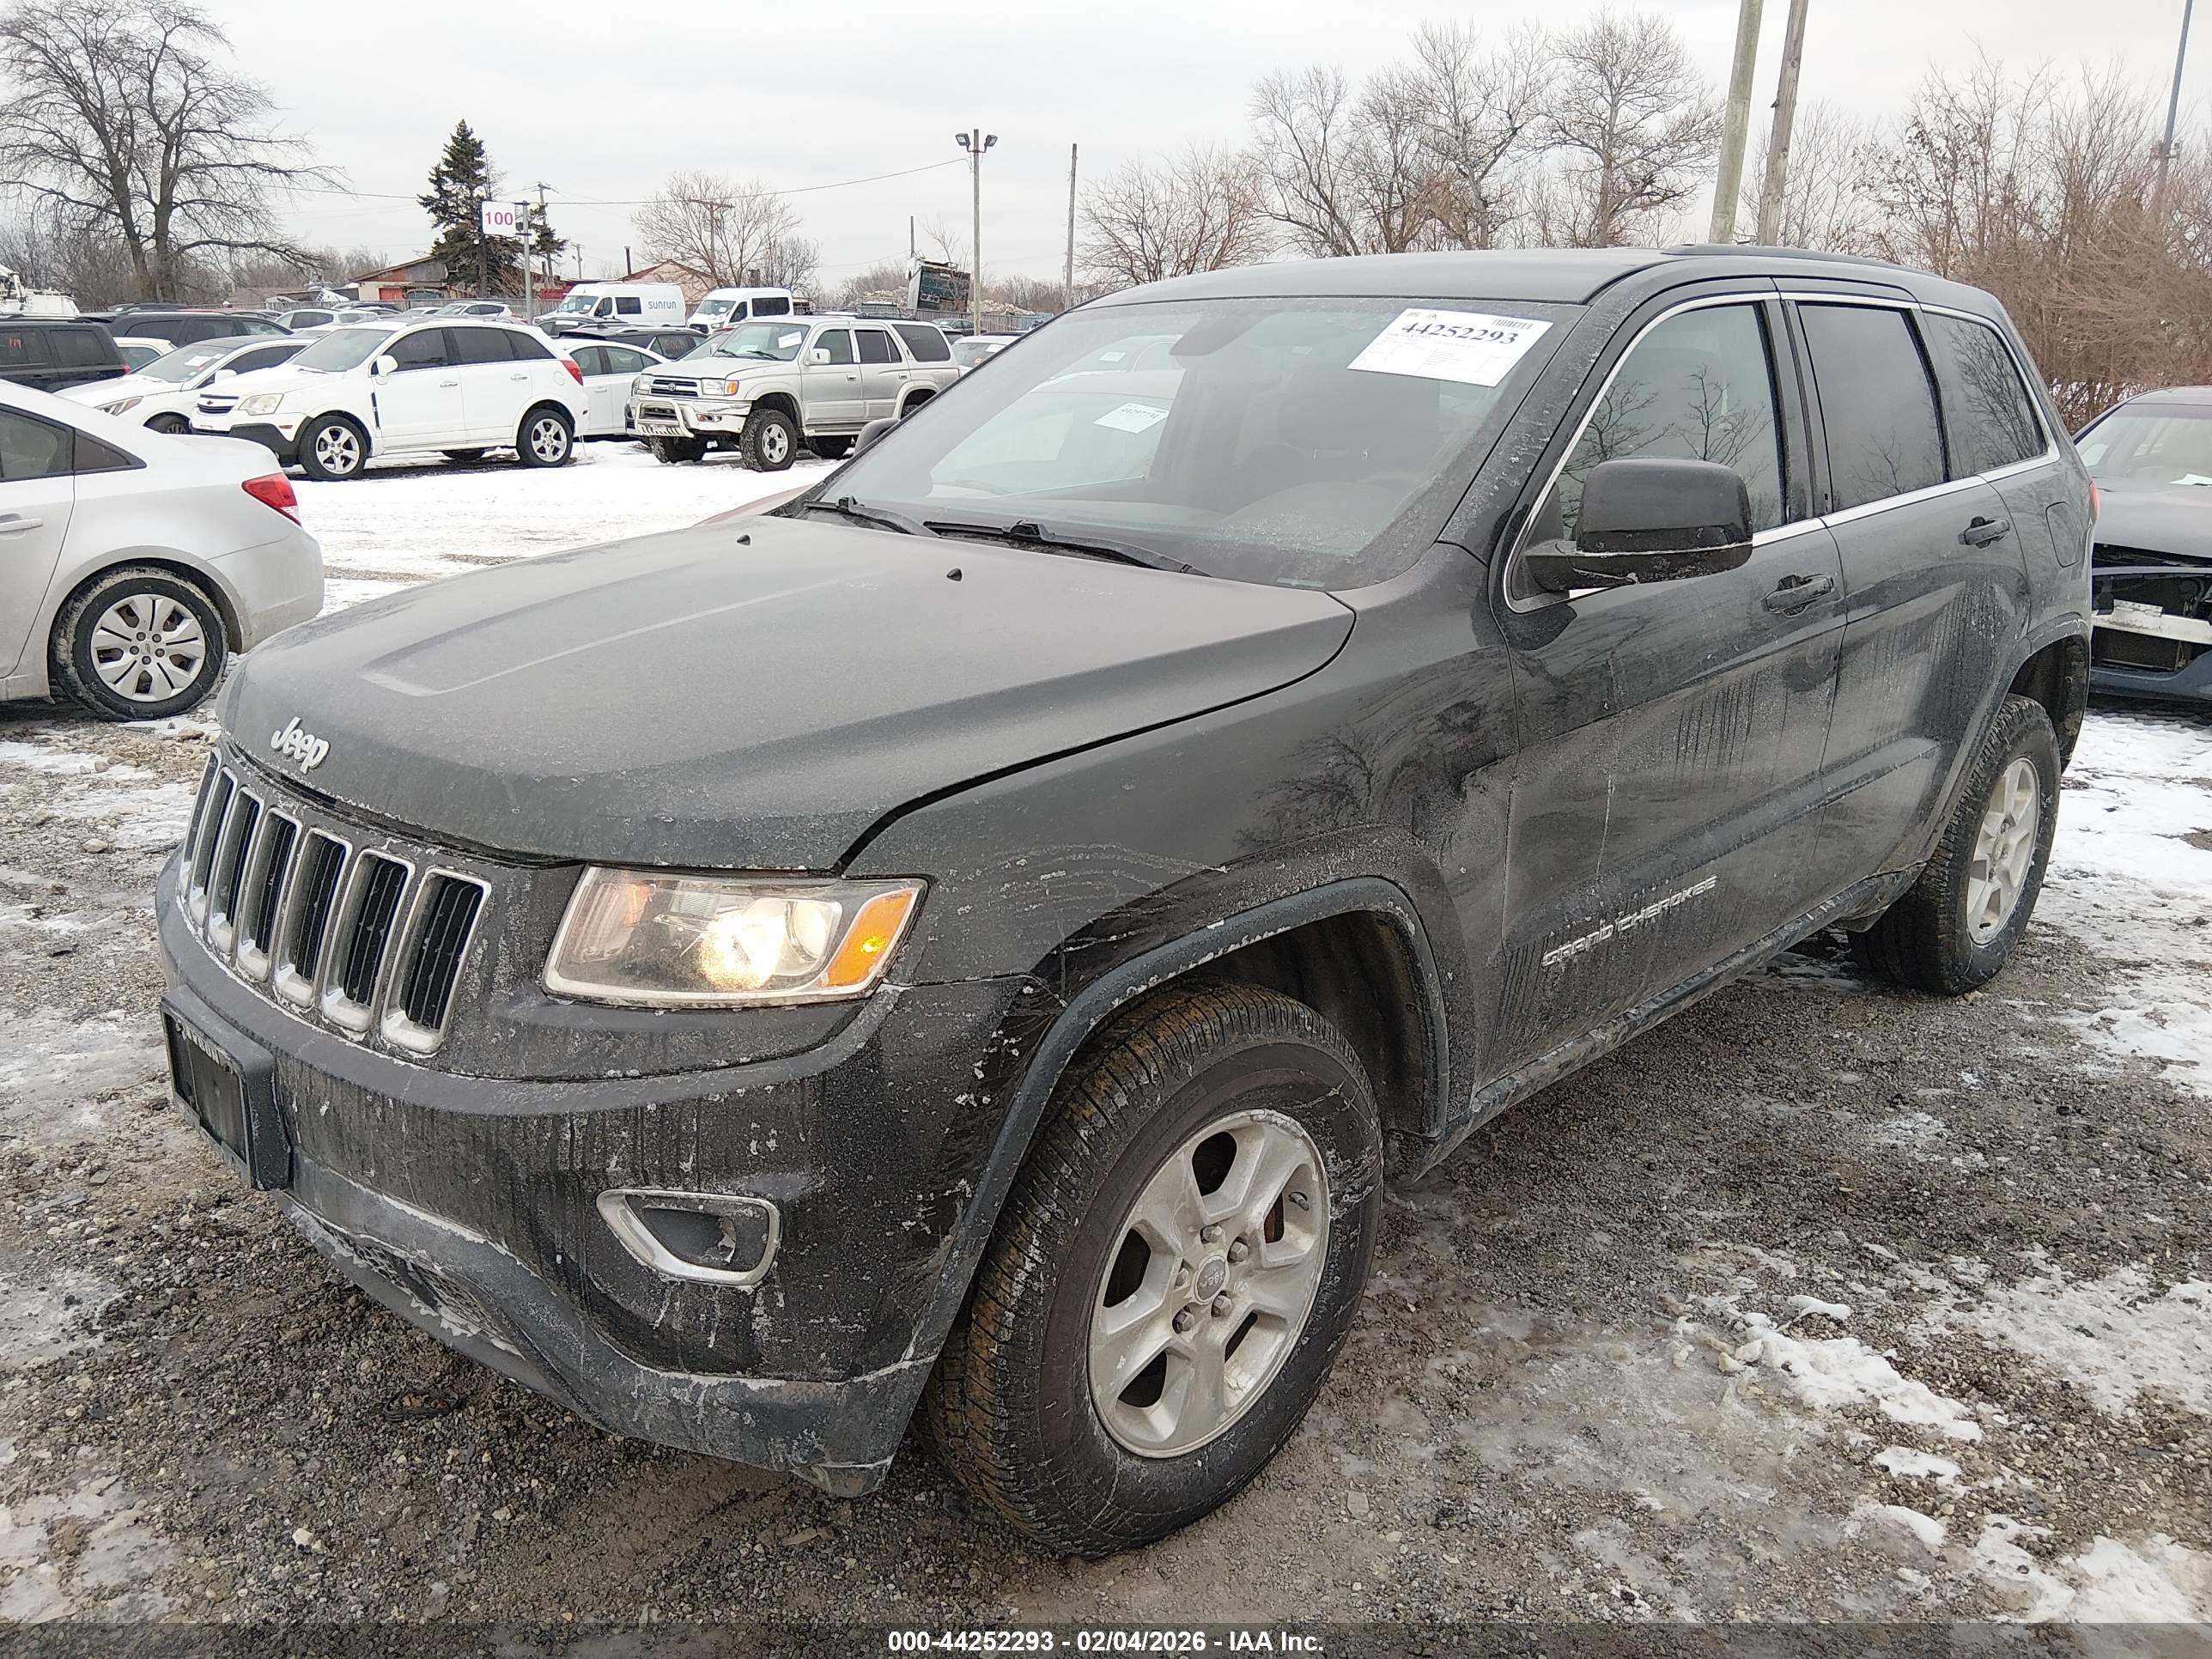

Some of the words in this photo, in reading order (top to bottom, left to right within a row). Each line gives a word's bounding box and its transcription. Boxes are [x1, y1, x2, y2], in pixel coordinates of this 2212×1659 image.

[484, 211, 514, 225] 100
[647, 301, 678, 310] sunrun
[1401, 322, 1519, 344] 44252293
[270, 716, 330, 775] Jeep
[1542, 924, 1613, 967] GRAND
[1618, 875, 1717, 932] CHEROKEE
